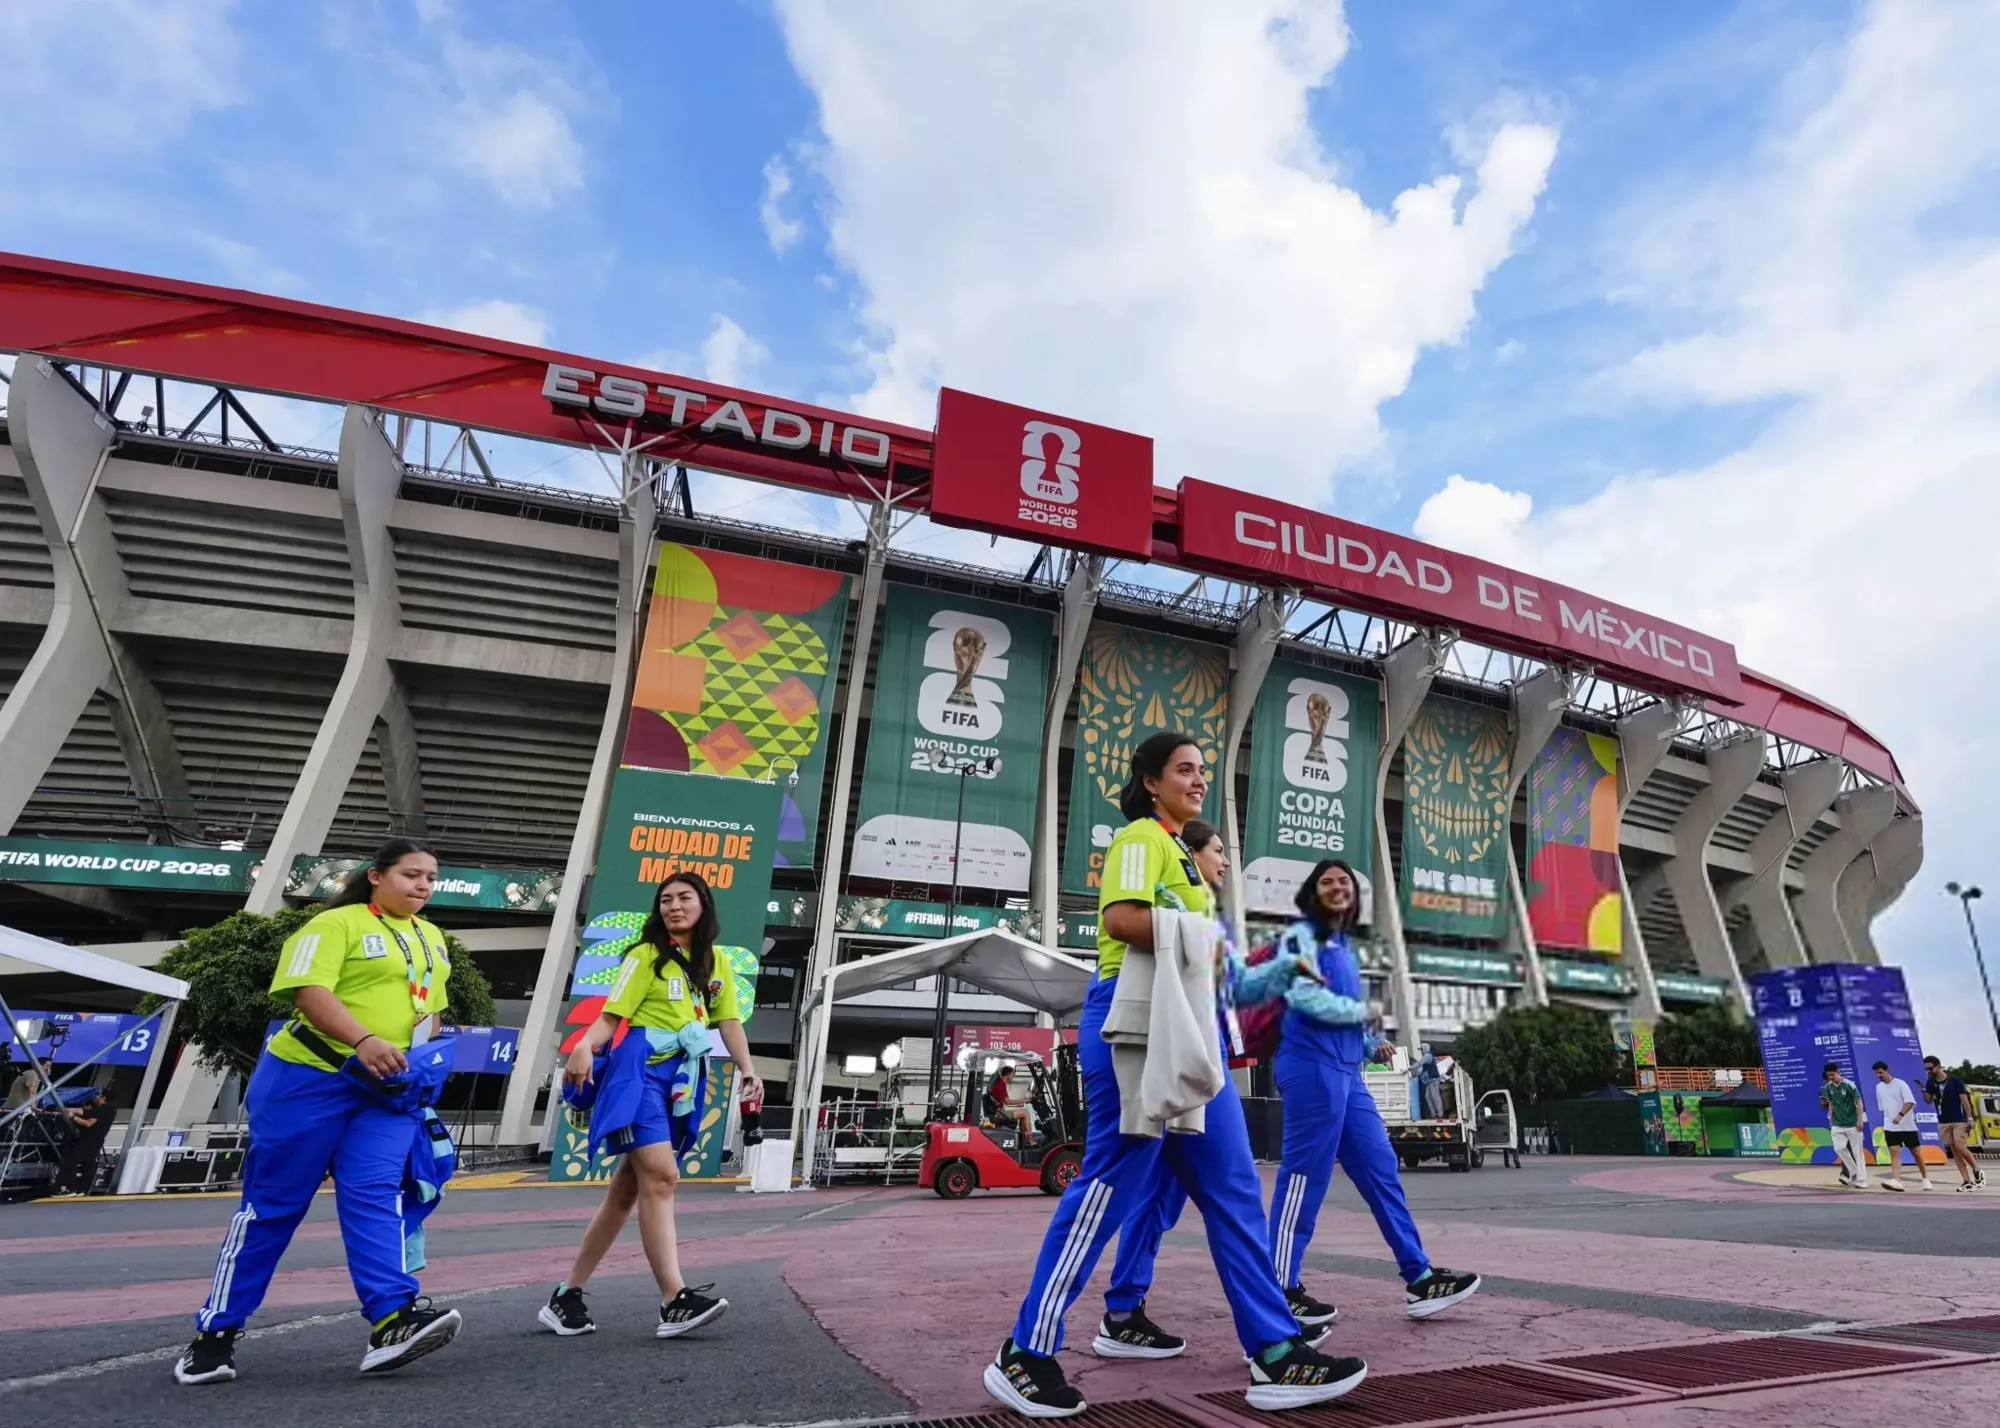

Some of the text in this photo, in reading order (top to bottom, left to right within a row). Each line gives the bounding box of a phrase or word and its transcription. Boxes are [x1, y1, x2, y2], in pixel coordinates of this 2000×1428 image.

[542, 363, 890, 467] ESTADIO
[1037, 483, 1063, 496] FIFA
[1018, 507, 1077, 529] 2026
[1019, 498, 1078, 516] WORLD CUP
[1234, 510, 1714, 678] CIUDAD DE MÉXICO
[941, 710, 979, 728] FIFA
[913, 737, 999, 757] WORLD CUP
[1301, 766, 1330, 782] FIFA
[1280, 790, 1345, 819] COPA
[633, 813, 740, 831] BIENVENIDOS
[1279, 812, 1345, 834] MUNDIAL
[629, 825, 753, 860] CIUDAD DE
[1277, 828, 1345, 851] 2026
[0, 851, 231, 876] FIFA WORLD CUP 2026
[433, 879, 481, 896] orldCup
[1413, 866, 1446, 893] WE
[121, 1029, 151, 1052] 13
[492, 1041, 512, 1062] 14
[1003, 1140, 1015, 1148] 25
